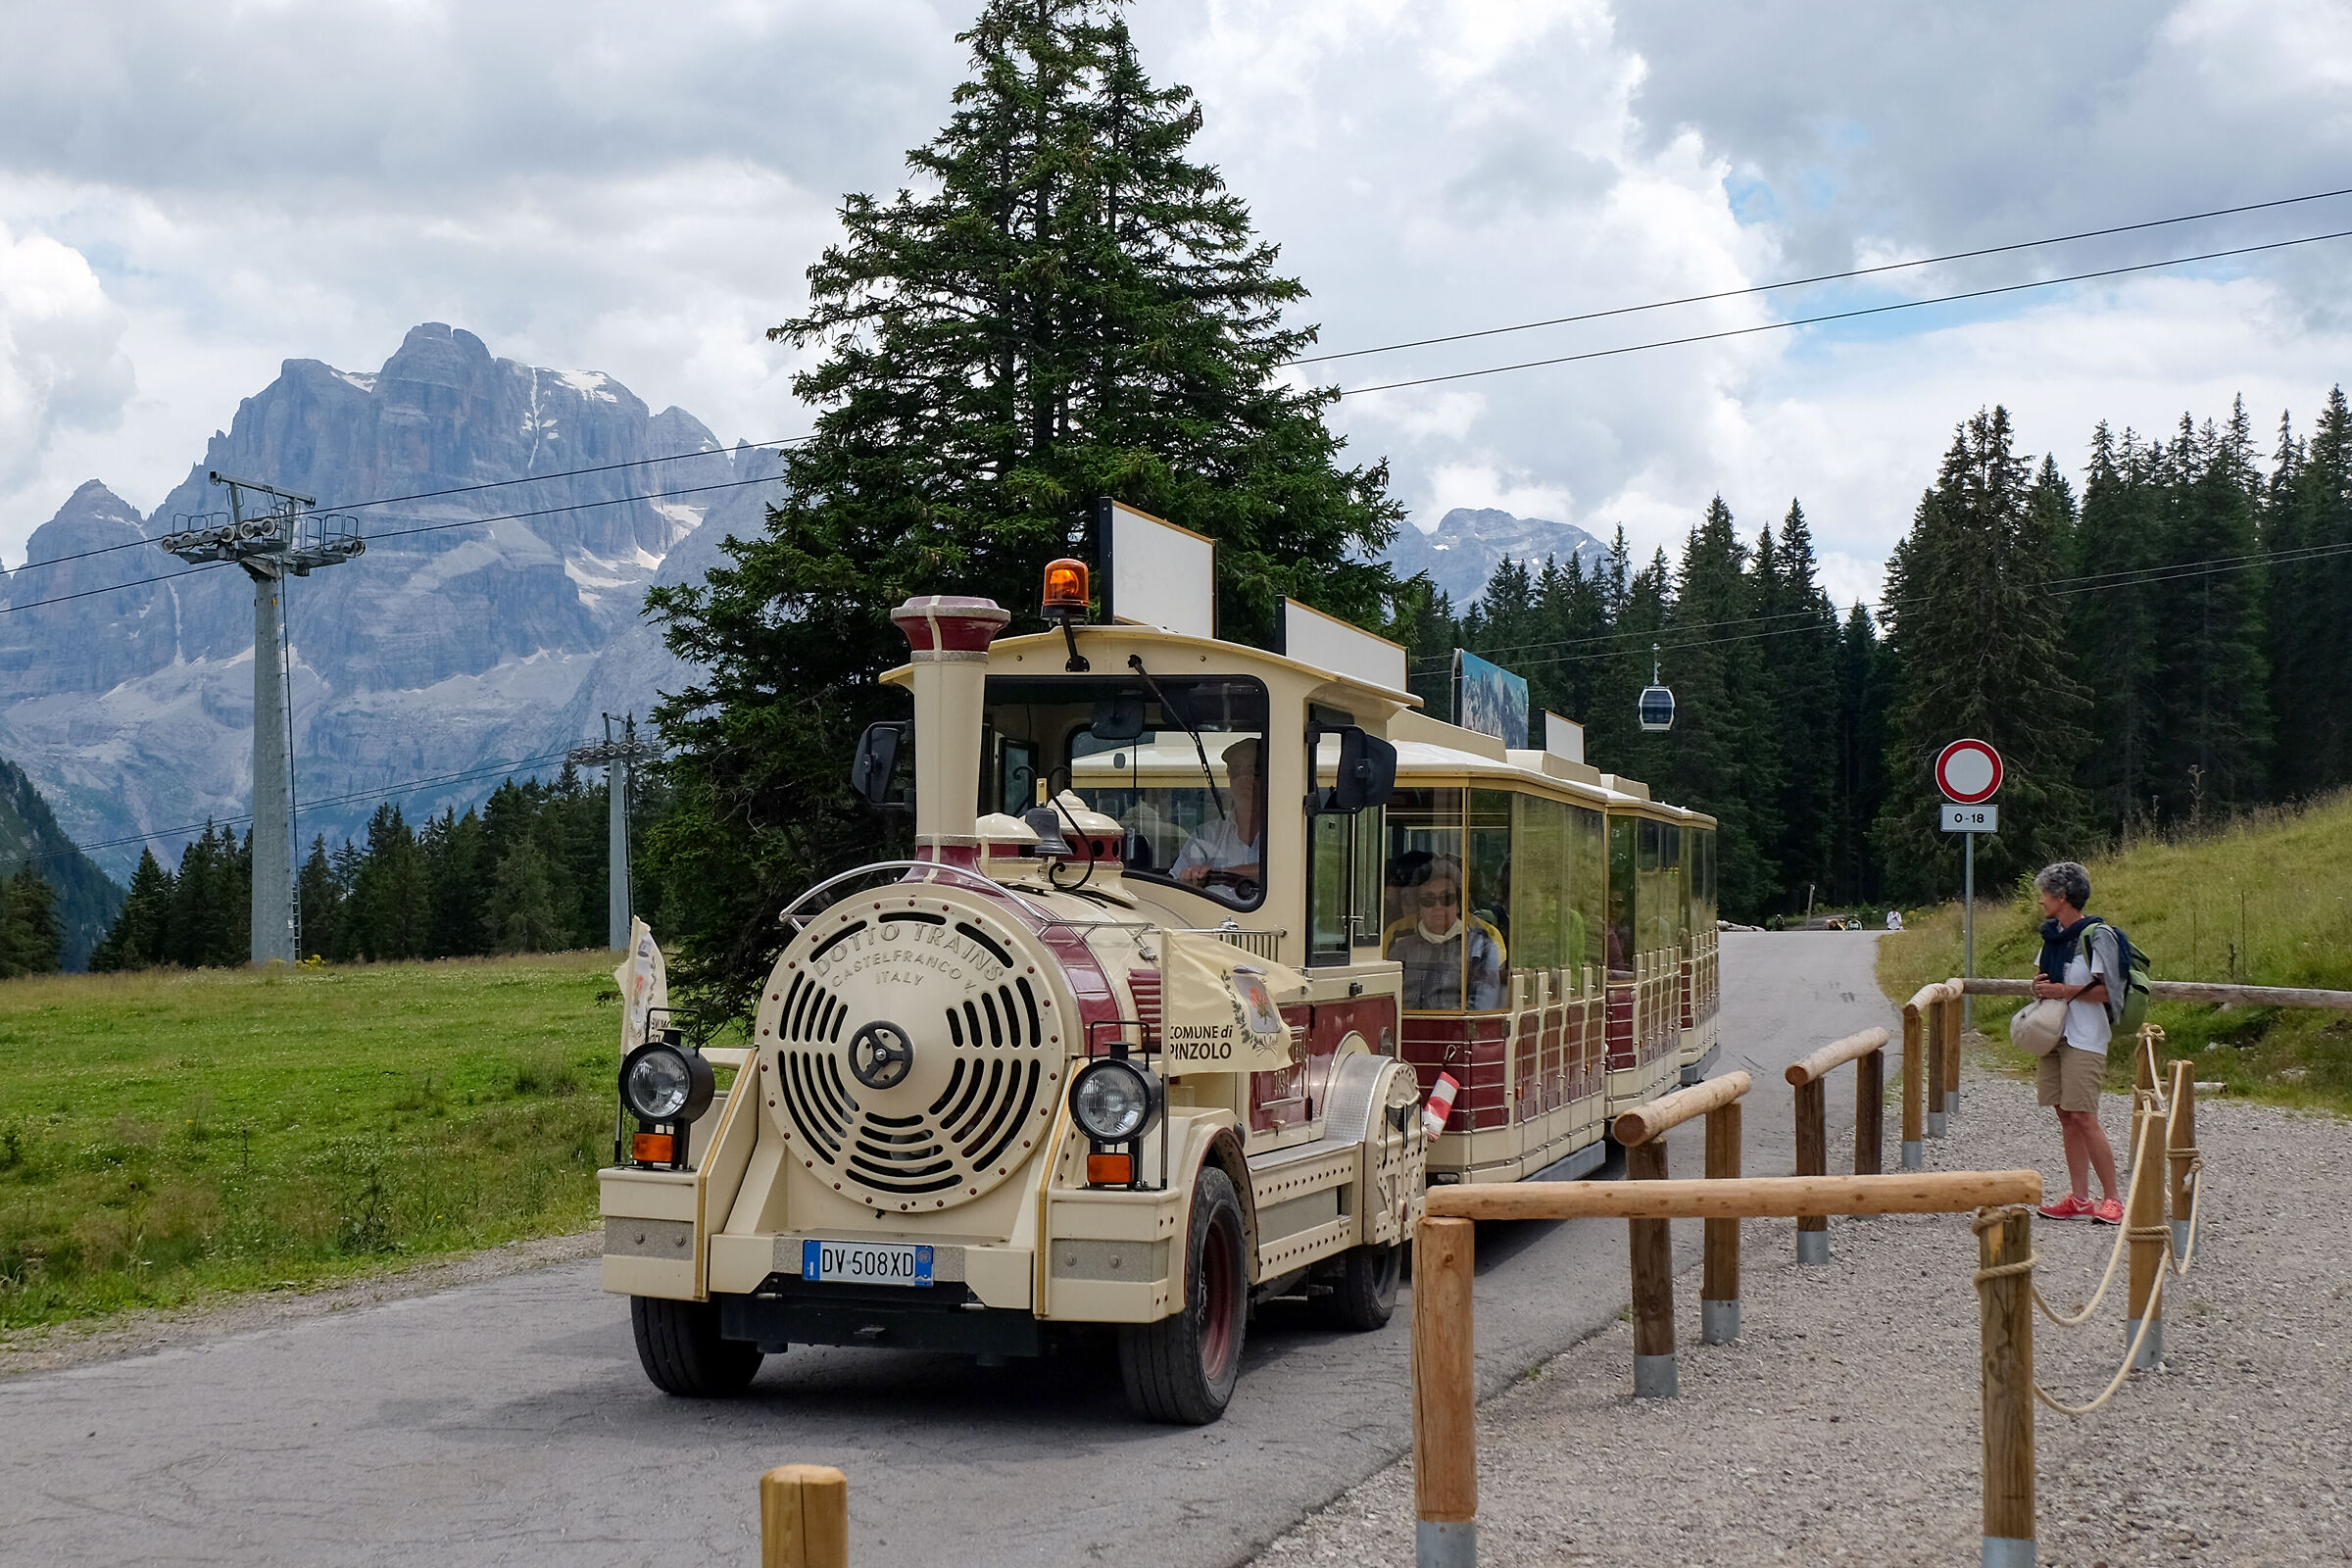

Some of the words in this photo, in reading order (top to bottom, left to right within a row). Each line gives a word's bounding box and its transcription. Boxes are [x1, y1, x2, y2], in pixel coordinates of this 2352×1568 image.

[812, 923, 901, 977] DOTTO
[913, 923, 1004, 981] TRAINS
[832, 950, 963, 988] CASTELFRANCO
[875, 971, 925, 986] ITALY
[1220, 1024, 1234, 1039] di
[821, 1249, 846, 1274] DV
[852, 1250, 914, 1277] 508XD
